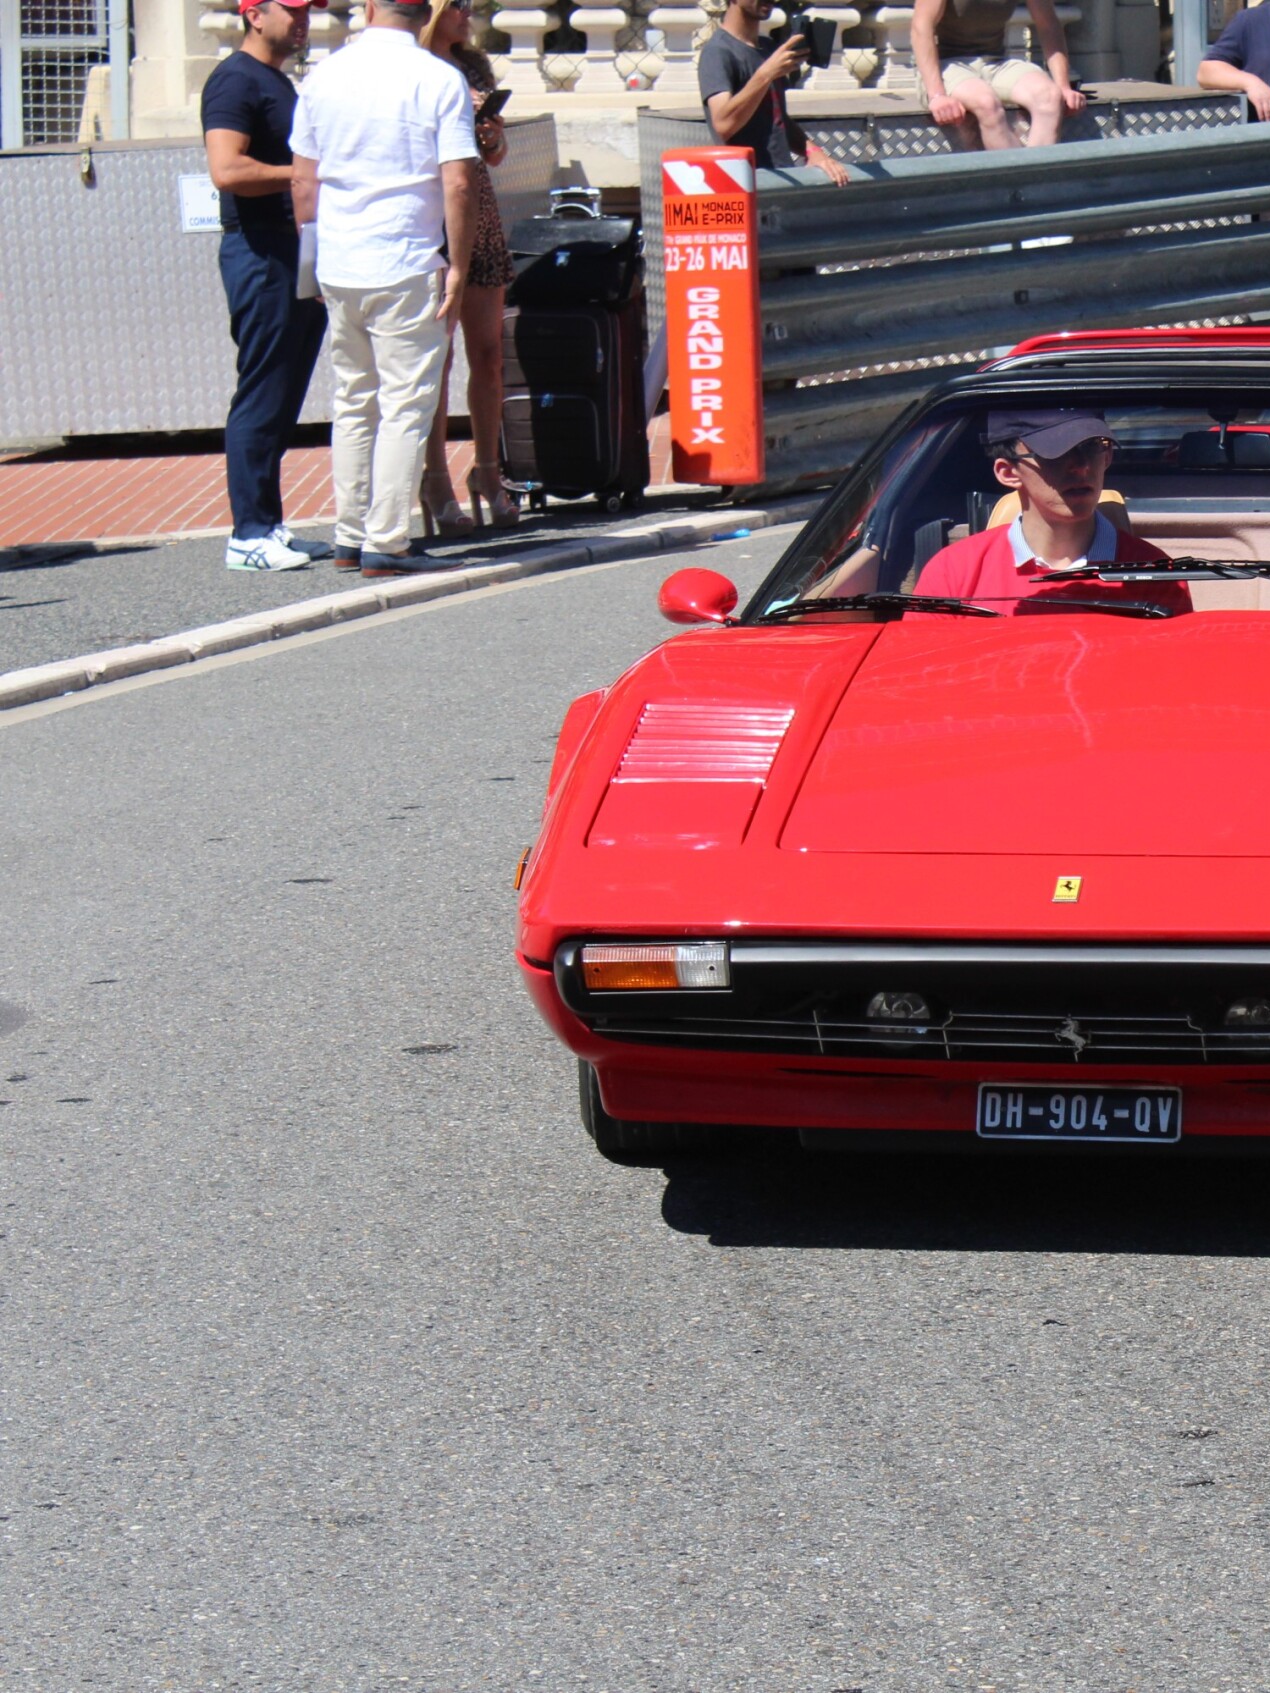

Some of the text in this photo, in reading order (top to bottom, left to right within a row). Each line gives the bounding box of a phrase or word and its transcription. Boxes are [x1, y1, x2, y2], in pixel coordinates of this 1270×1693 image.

[702, 201, 745, 212] MONACO
[702, 212, 745, 226] E-PRIX
[665, 246, 748, 272] 23-26 MAI
[686, 286, 726, 445] GRAND PRIX
[984, 1092, 1173, 1133] DH-904-QV
